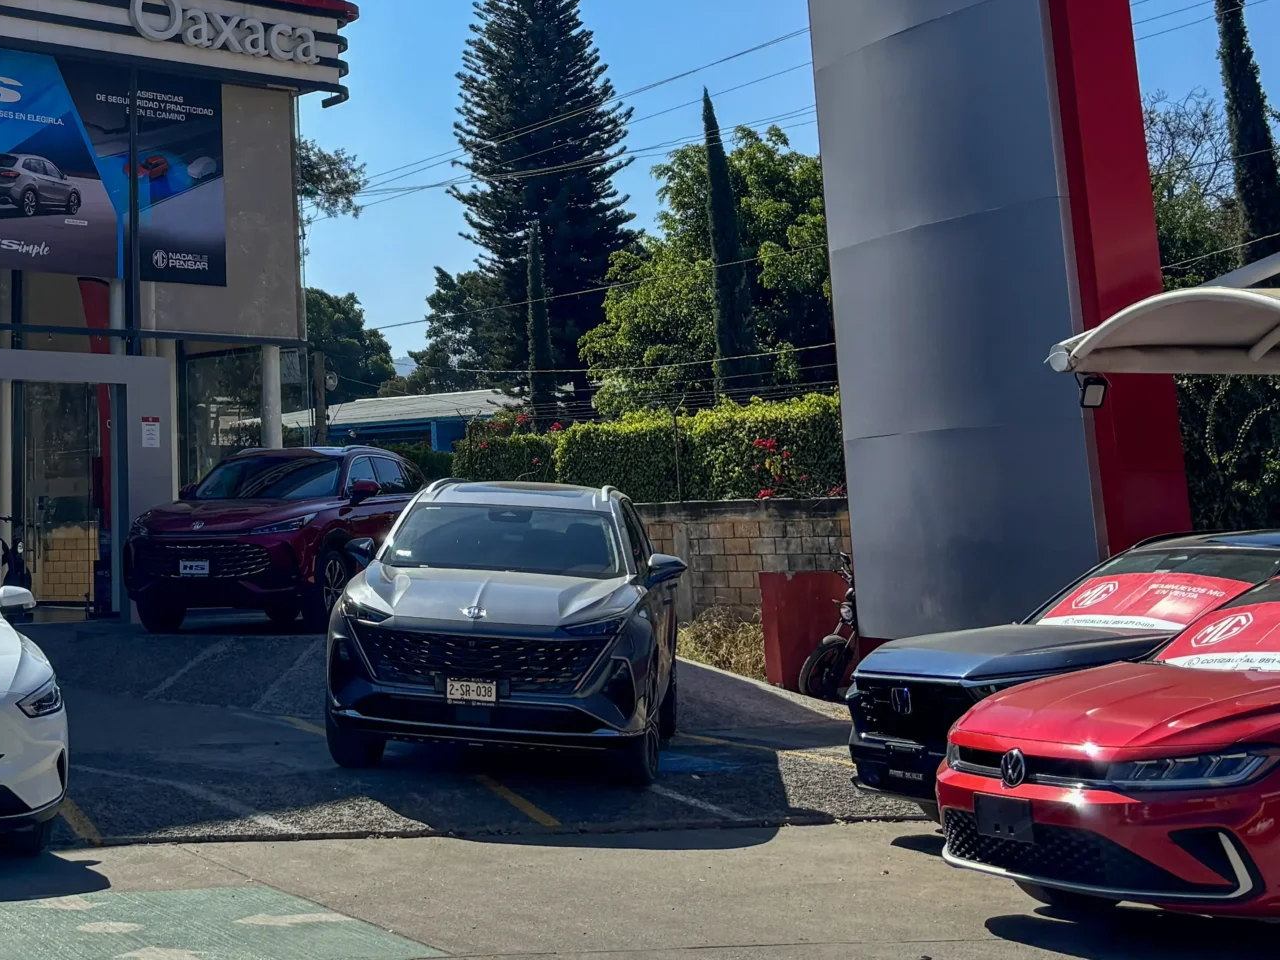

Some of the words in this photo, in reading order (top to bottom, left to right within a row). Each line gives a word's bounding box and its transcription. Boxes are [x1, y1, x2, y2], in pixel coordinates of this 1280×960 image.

[136, 89, 184, 103] ASISTENCIAS
[95, 93, 107, 102] DE
[160, 102, 166, 110] Y
[166, 103, 214, 116] PRACTICIDAD
[15, 111, 26, 120] EN
[27, 112, 65, 126] ELEGIRLA.
[146, 109, 156, 118] EL
[156, 111, 186, 122] CAMINO
[168, 259, 209, 271] PENSAR
[448, 683, 494, 698] 2-SR-038
